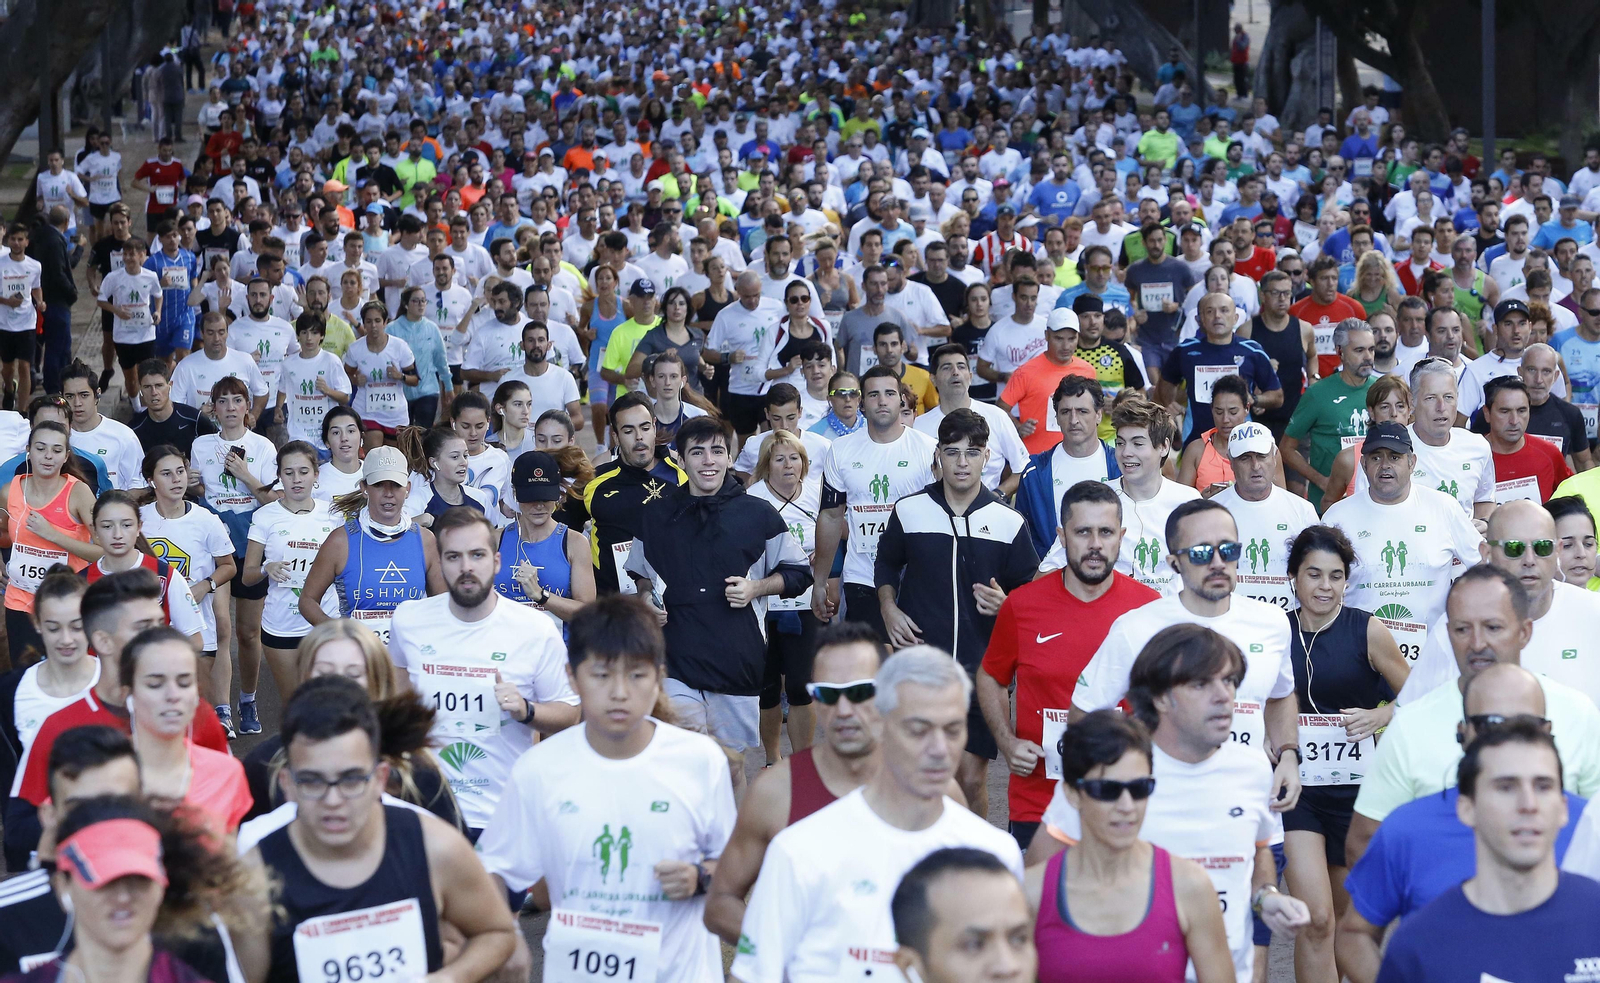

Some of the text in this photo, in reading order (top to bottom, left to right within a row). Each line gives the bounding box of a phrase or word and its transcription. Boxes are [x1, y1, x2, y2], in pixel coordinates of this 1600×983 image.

[369, 393, 396, 403] 17431
[300, 406, 324, 416] 1615
[859, 522, 887, 536] 174
[16, 544, 24, 553] 41
[615, 543, 626, 553] 41
[19, 562, 46, 580] 159
[1399, 643, 1421, 661] 93
[422, 663, 435, 674] 41
[436, 664, 468, 672] CARRERA
[433, 691, 483, 712] 1011
[1046, 711, 1059, 723] 41
[1306, 742, 1362, 762] 3174
[557, 912, 574, 927] 41
[848, 947, 868, 961] 41
[322, 947, 406, 983] 9633
[568, 948, 636, 981] 1091
